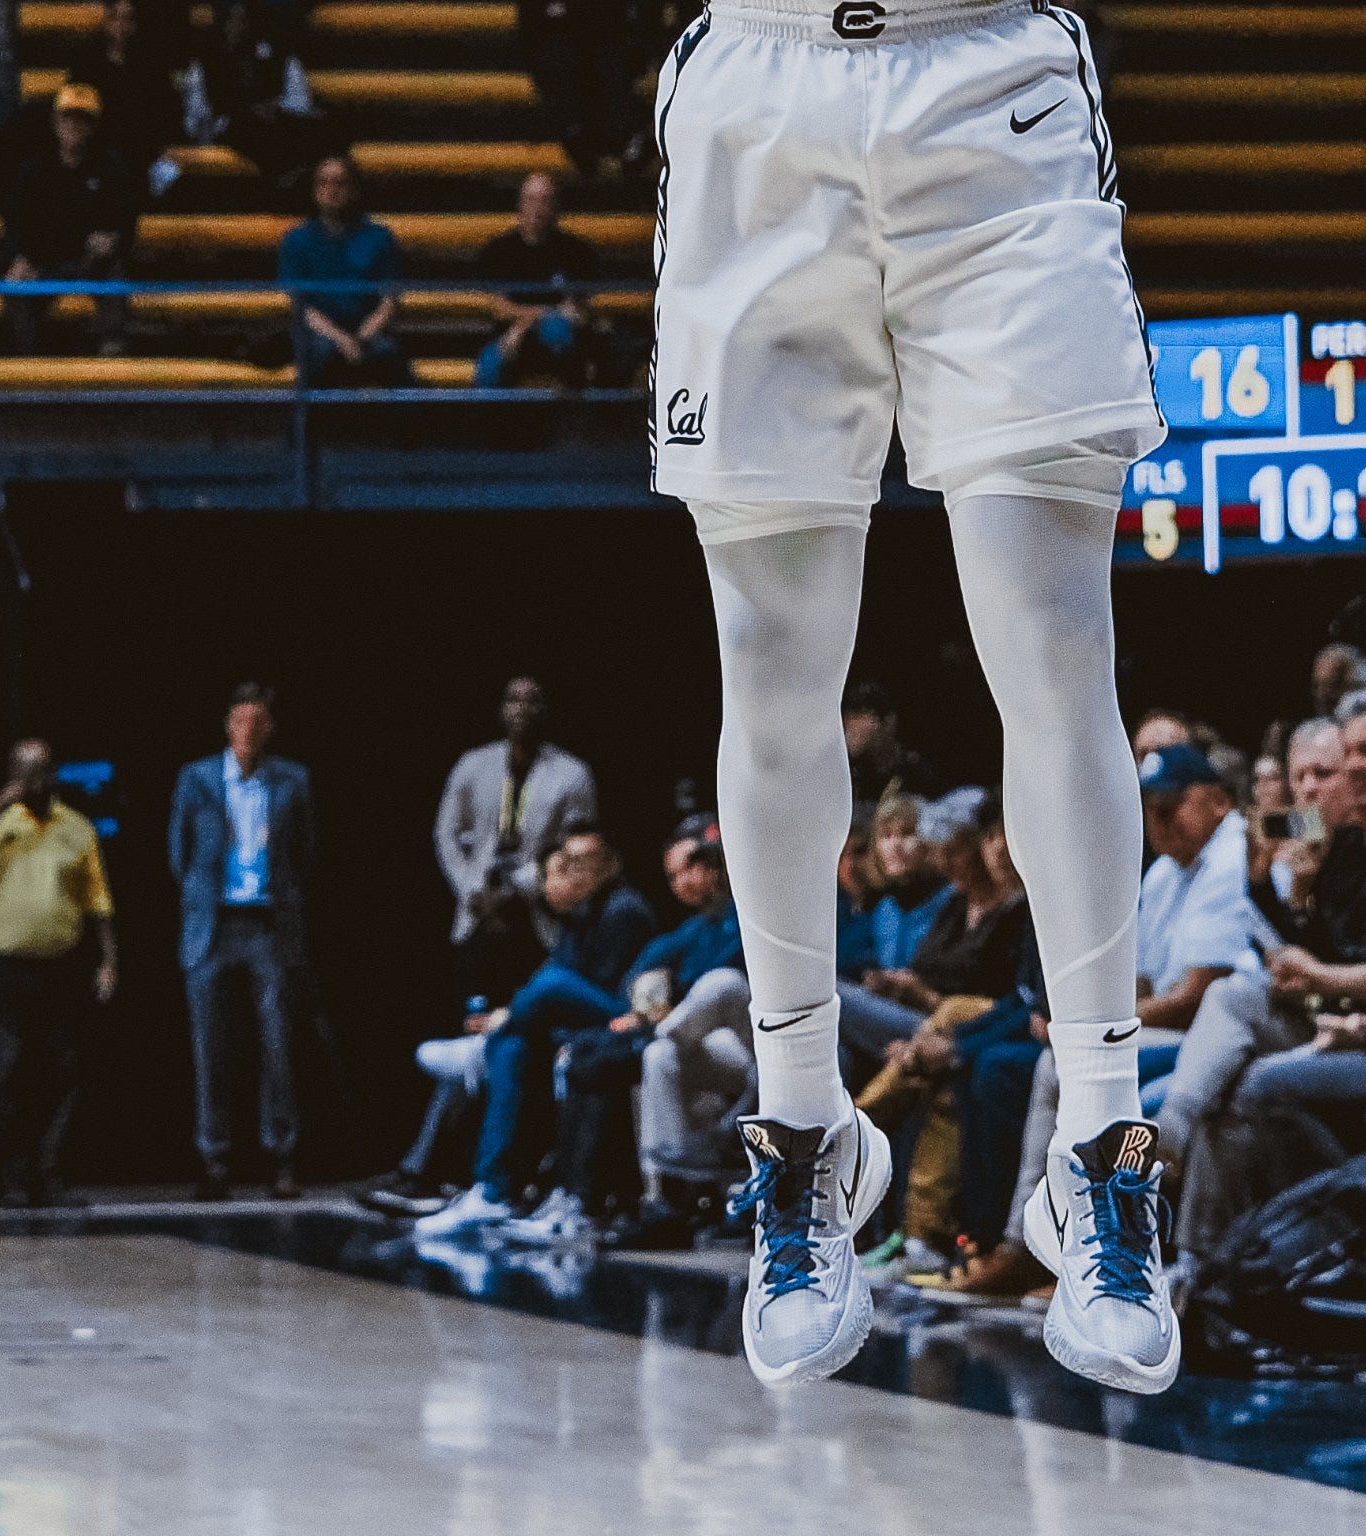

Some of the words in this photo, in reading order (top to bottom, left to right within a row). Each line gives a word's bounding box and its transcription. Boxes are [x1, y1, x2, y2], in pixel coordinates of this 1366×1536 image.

[1191, 345, 1270, 420] 16
[1326, 360, 1355, 425] 1
[665, 388, 708, 445] Cal
[1142, 499, 1179, 562] 5
